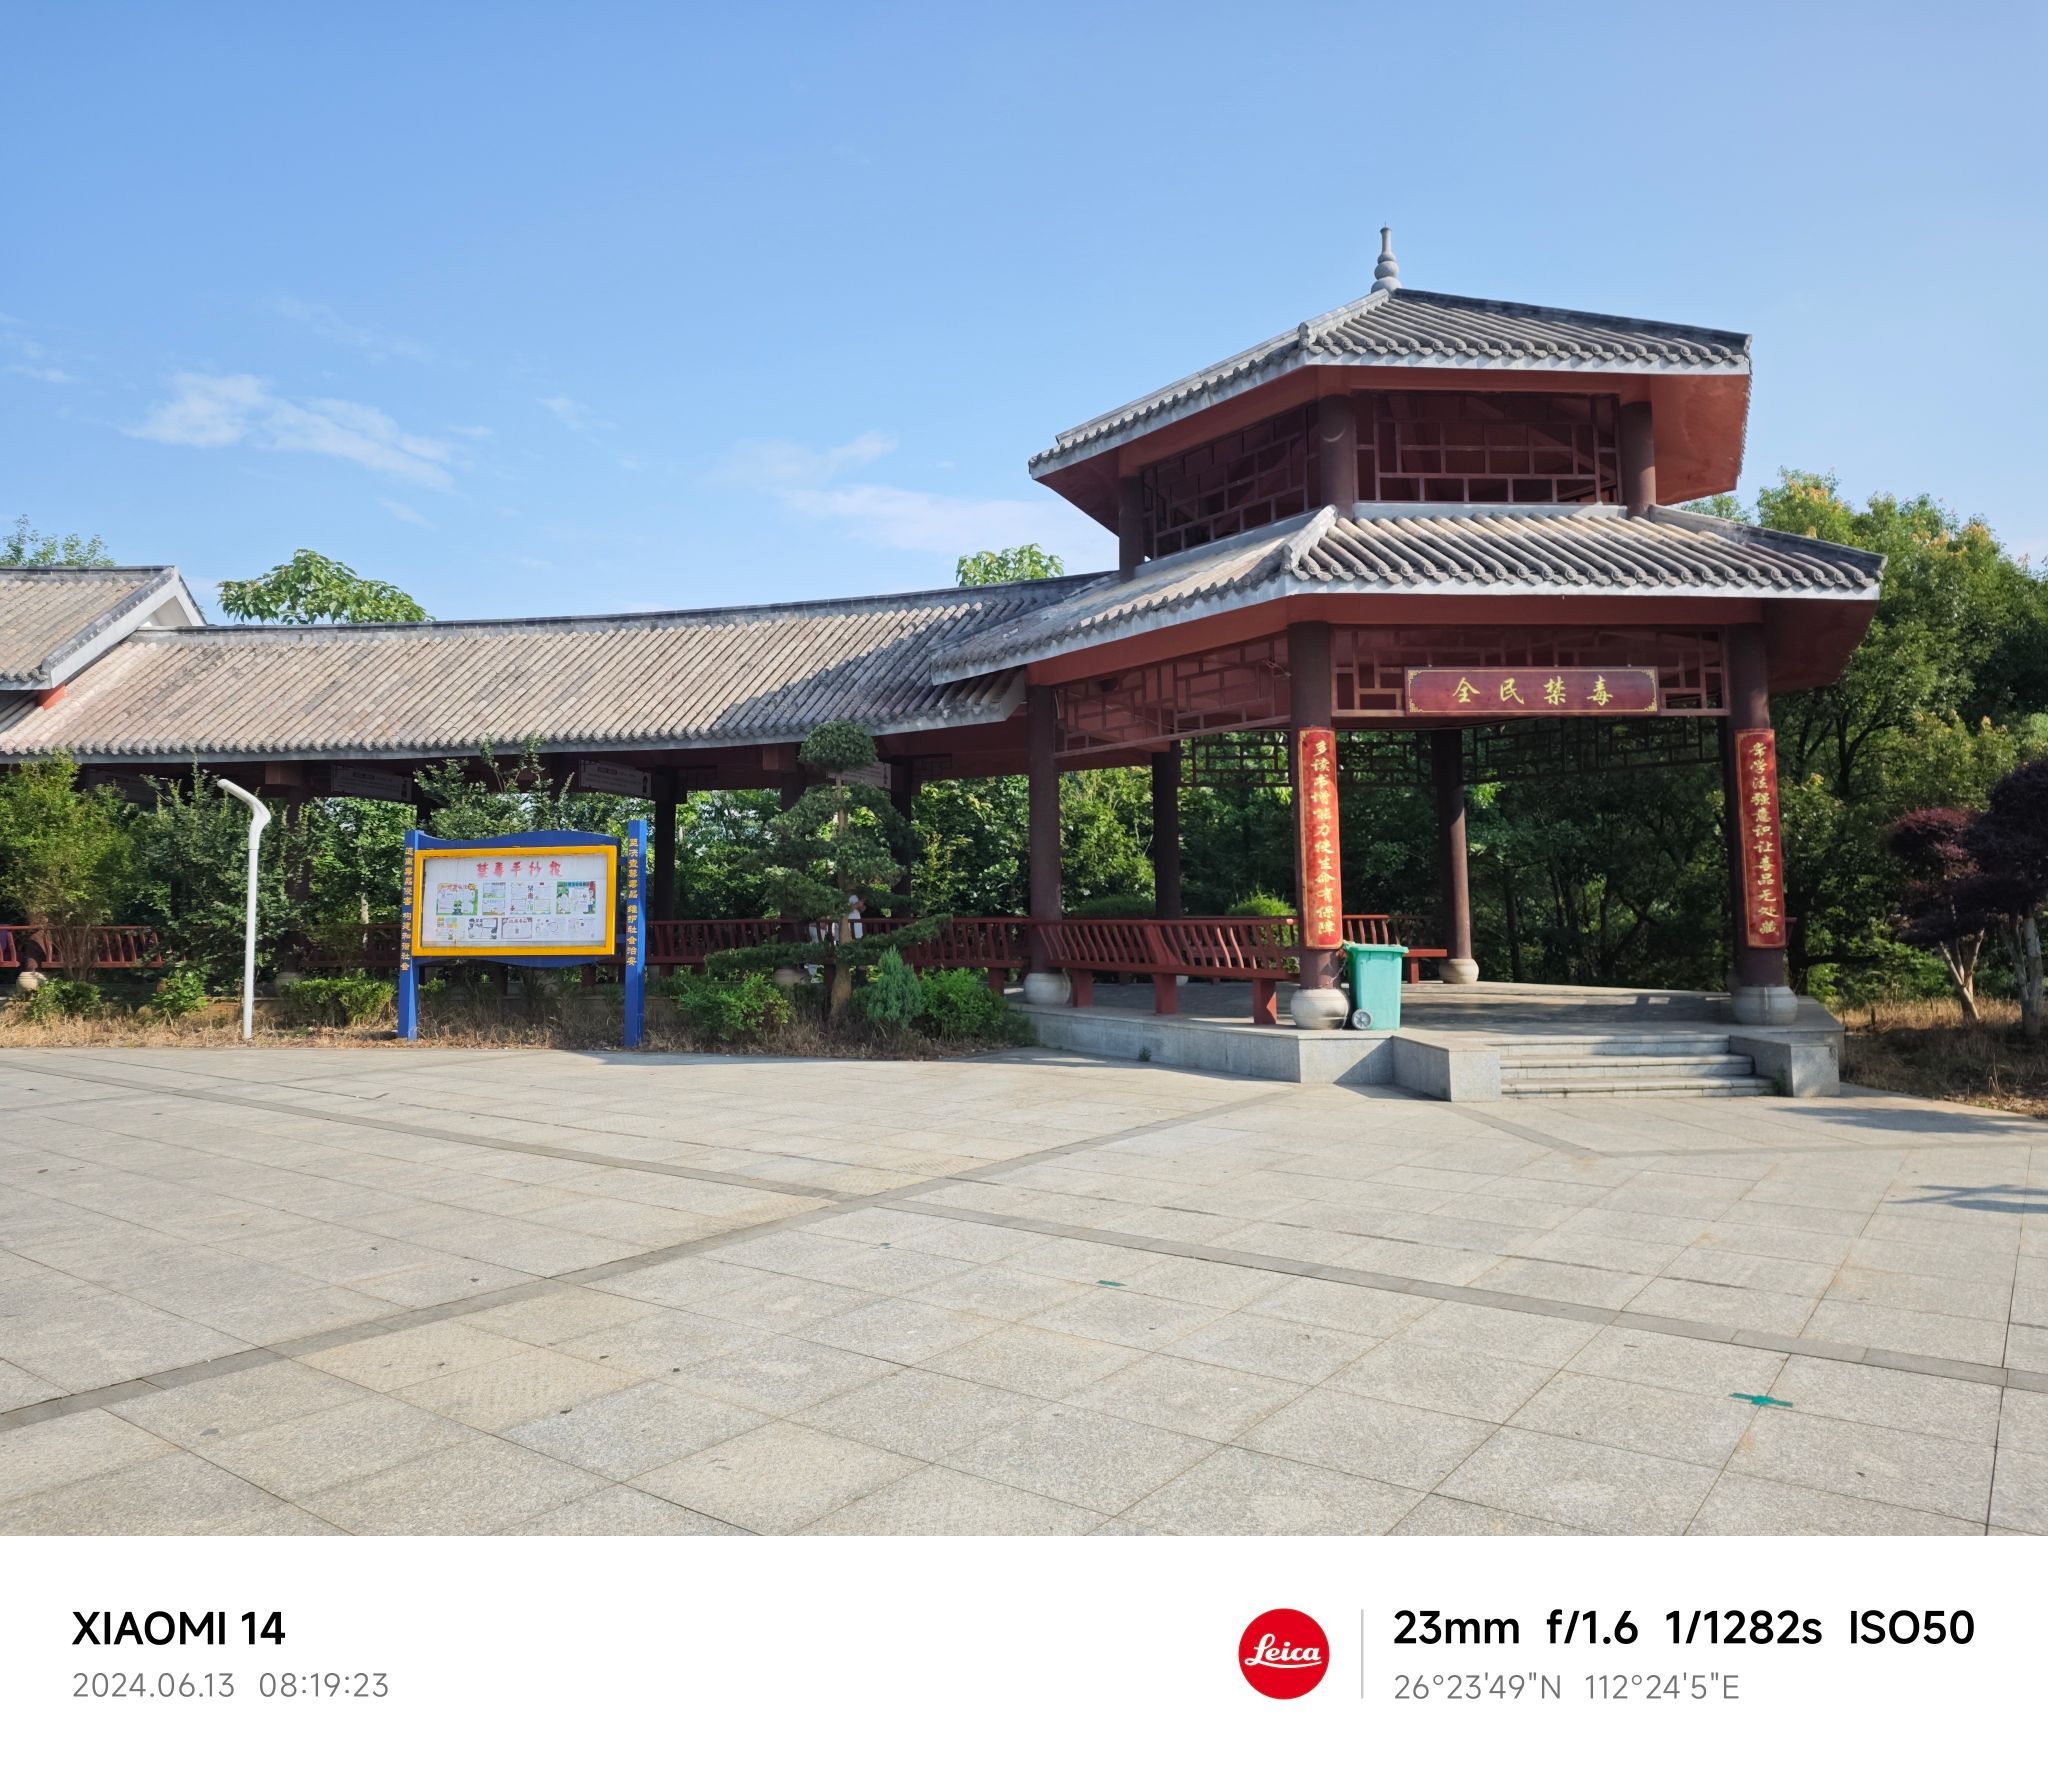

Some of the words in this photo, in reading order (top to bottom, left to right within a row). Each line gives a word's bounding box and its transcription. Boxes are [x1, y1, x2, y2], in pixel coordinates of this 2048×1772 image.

[1452, 675, 1614, 706] 全民禁毒
[1310, 740, 1336, 936] 多读书增能力使生命有保障
[1749, 742, 1780, 936] 常学法强意识让毒品无处藏
[400, 912, 412, 971] 构建和谐社会
[626, 904, 638, 966] 维护社会治安
